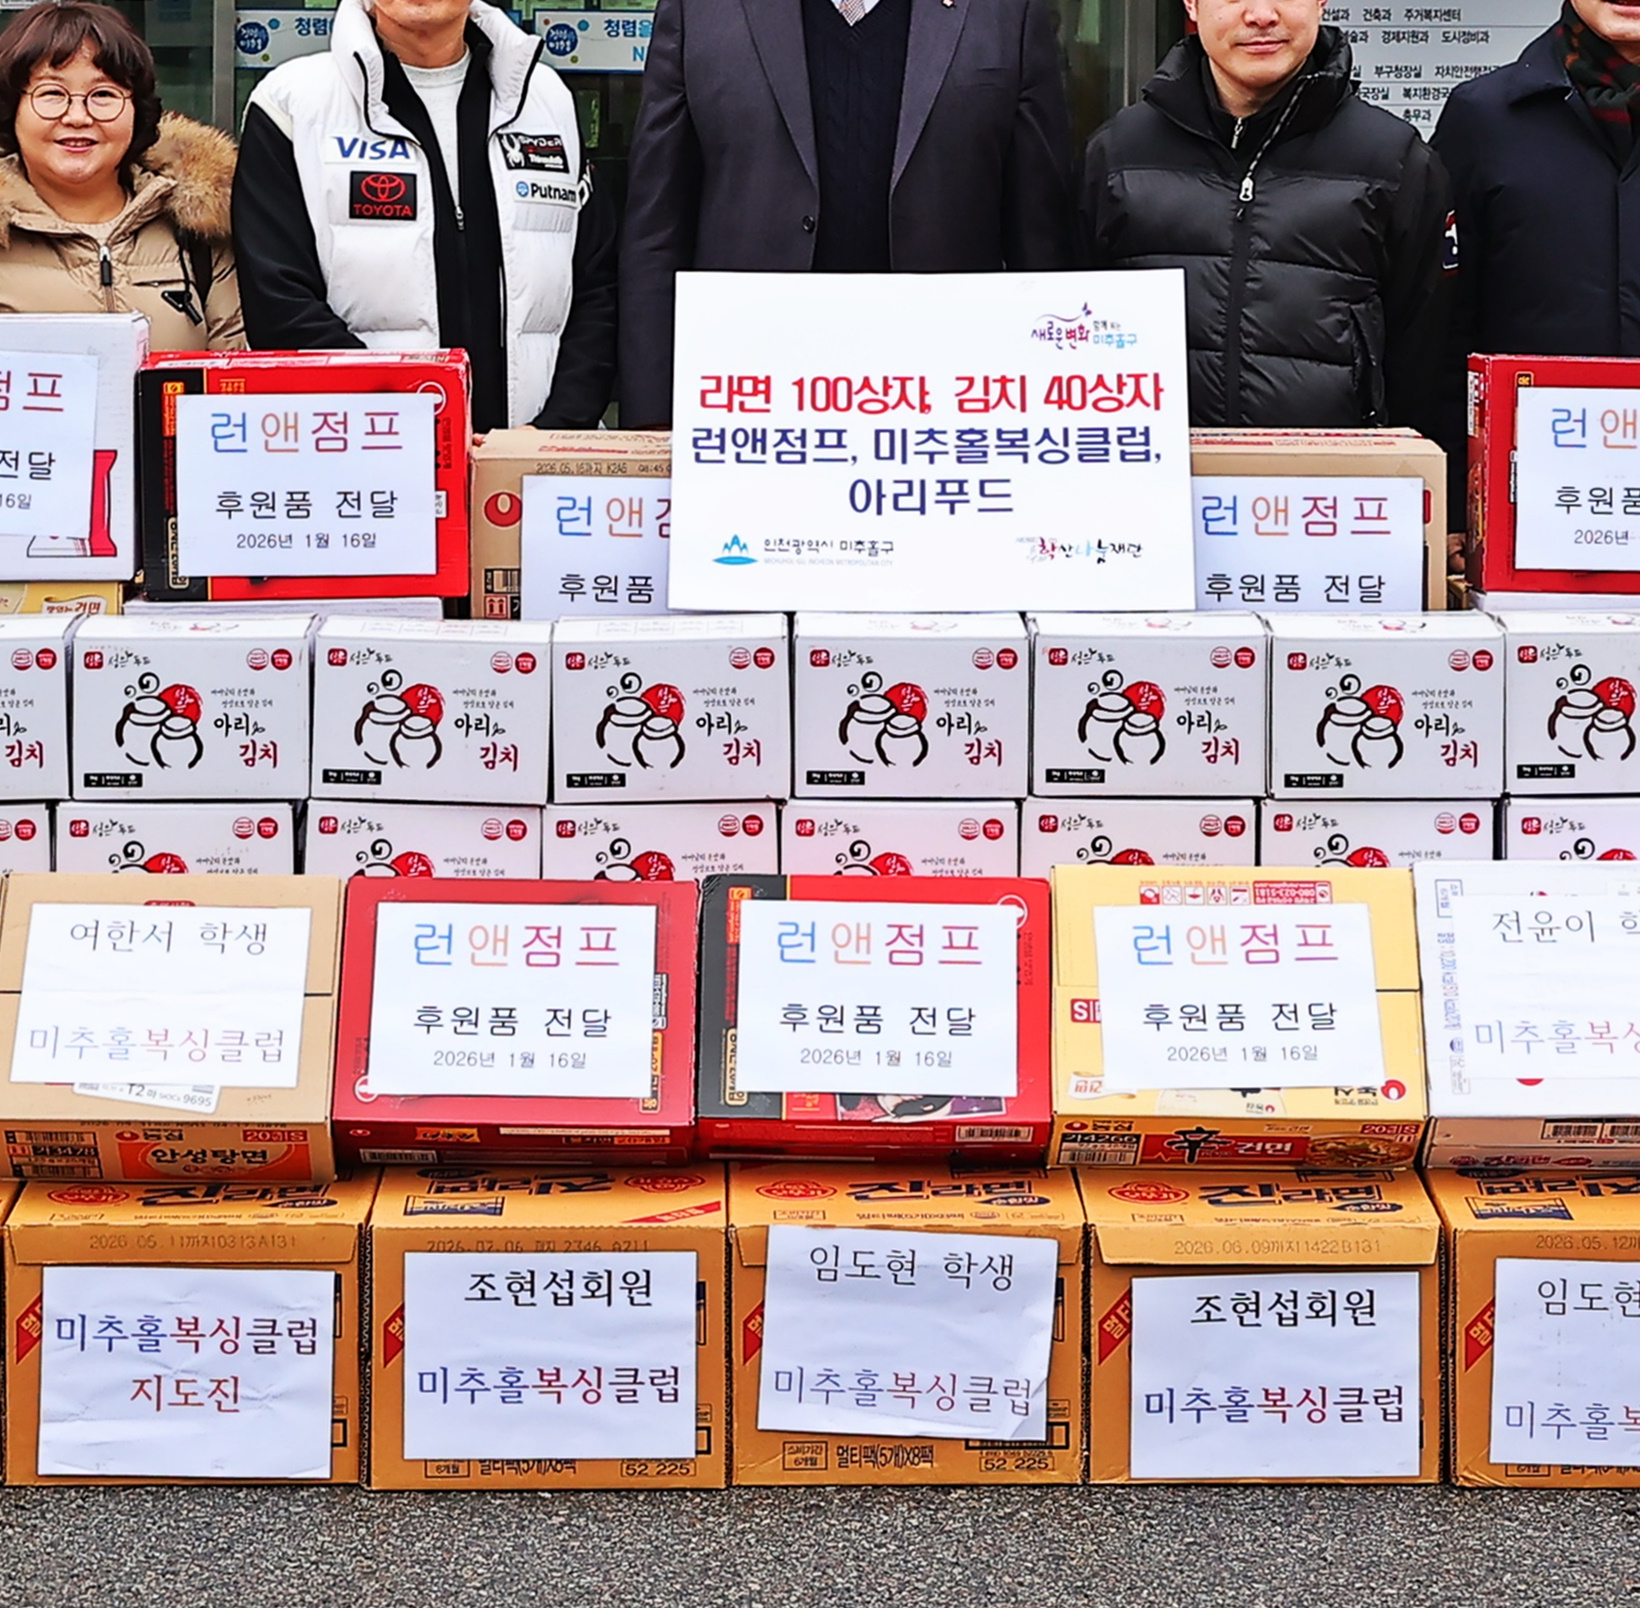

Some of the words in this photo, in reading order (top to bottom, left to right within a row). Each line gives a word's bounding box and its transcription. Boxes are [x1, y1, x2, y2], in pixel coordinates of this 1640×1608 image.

[335, 136, 411, 160] VISA
[353, 203, 412, 217] TOYOTA
[530, 183, 577, 203] Putnam
[700, 375, 771, 413] 라면
[792, 376, 932, 415] 100상자,
[955, 375, 1027, 413] 김치
[1044, 372, 1164, 413] 40상자
[211, 411, 403, 453] 런앤점프
[692, 428, 857, 465] 런앤점프,
[874, 426, 1161, 465] 미추홀복싱클럽,
[849, 479, 1013, 516] 아리푸드
[1202, 496, 1391, 536] 런앤점프
[764, 538, 834, 555] 인천광역시
[839, 539, 894, 557] 미추홀구
[1202, 737, 1241, 766] 김치
[70, 920, 172, 952] 여한서
[201, 923, 266, 955] 학생
[414, 924, 619, 967] 런앤점프
[778, 922, 982, 966] 런앤점프
[1133, 924, 1338, 965] 런앤점프
[1493, 911, 1594, 943] 전윤이
[780, 1004, 883, 1034] 후원품
[910, 1007, 975, 1036] 전달
[24, 1026, 283, 1067] 미추홀복싱클럽
[434, 1050, 495, 1068] 2026년
[510, 1052, 535, 1068] 1월
[550, 1052, 586, 1069] 16일
[183, 1094, 213, 1108] 9695
[151, 1148, 269, 1165] 안성탕면
[810, 1245, 915, 1285] 임도현
[944, 1252, 1013, 1291] 학생
[465, 1269, 652, 1307] 조현섭회원
[1191, 1289, 1376, 1327] 조현섭회원
[56, 1314, 316, 1355] 미추홀복싱클럽
[131, 1374, 239, 1412] 지도진
[418, 1366, 678, 1404] 미추홀복싱클럽
[772, 1365, 1032, 1416] 미추홀복싱클럽
[1145, 1385, 1402, 1423] 미추홀복싱클럽
[984, 1459, 1008, 1471] 52
[1015, 1459, 1049, 1471] 225
